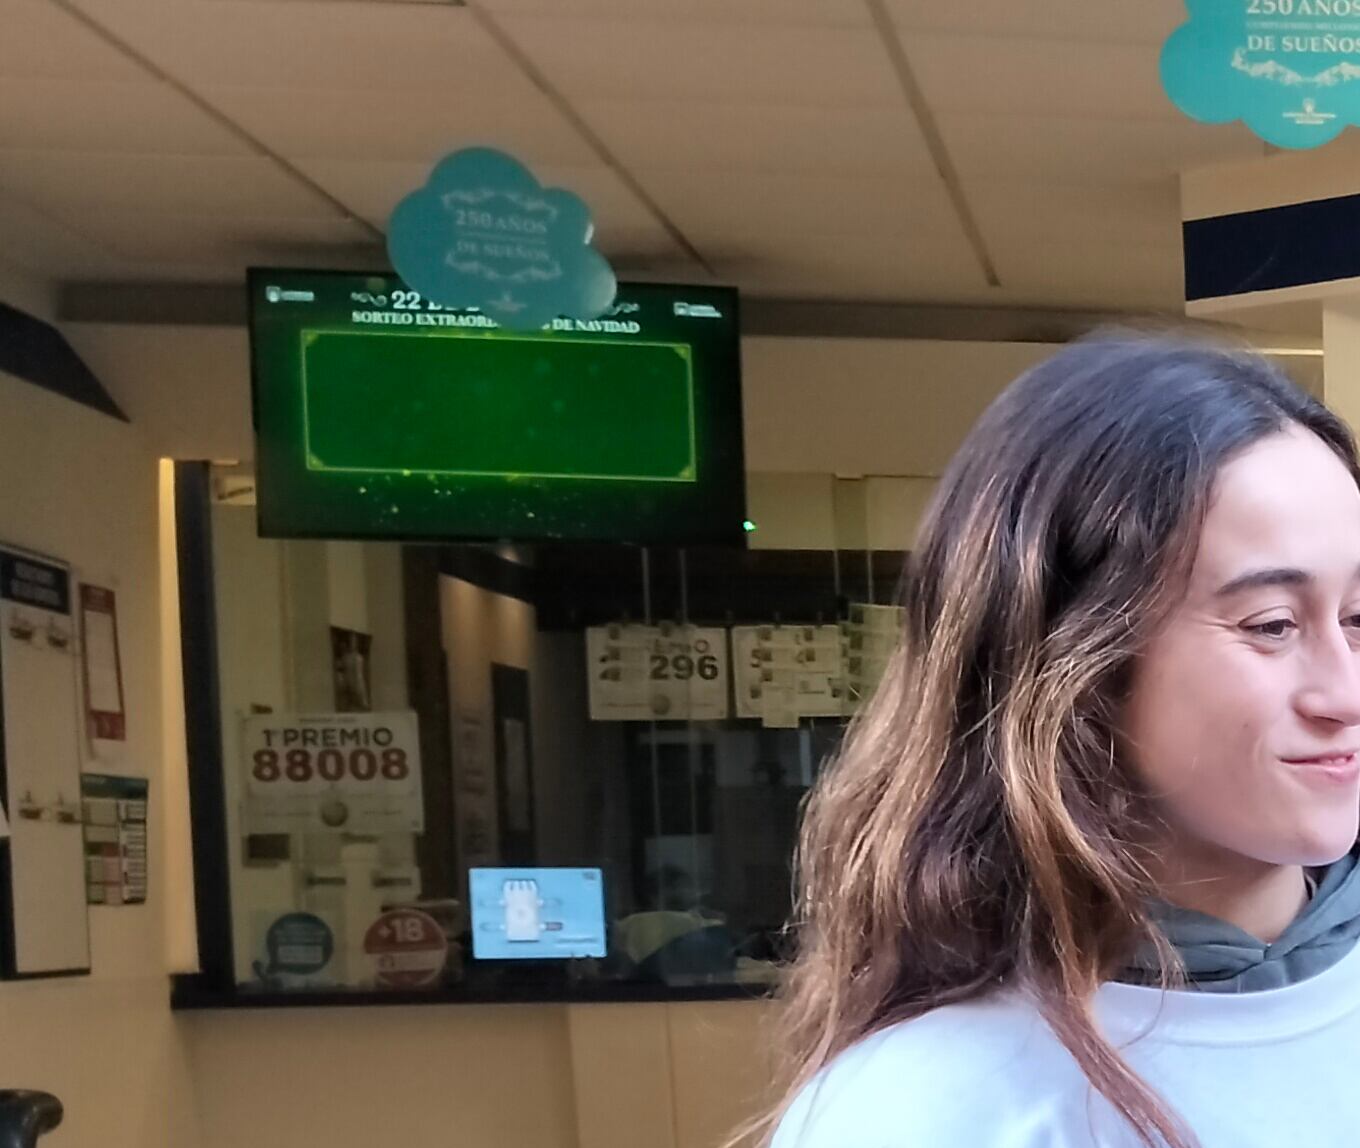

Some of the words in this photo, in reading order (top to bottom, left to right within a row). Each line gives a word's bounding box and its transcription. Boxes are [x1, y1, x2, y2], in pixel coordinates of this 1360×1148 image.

[1248, 35, 1275, 51] DE
[391, 290, 421, 310] 22
[352, 311, 413, 324] SORTEO
[552, 319, 574, 331] DE
[575, 319, 640, 333] NAVIDAD
[283, 727, 393, 747] PREMIO
[253, 748, 409, 782] 88008
